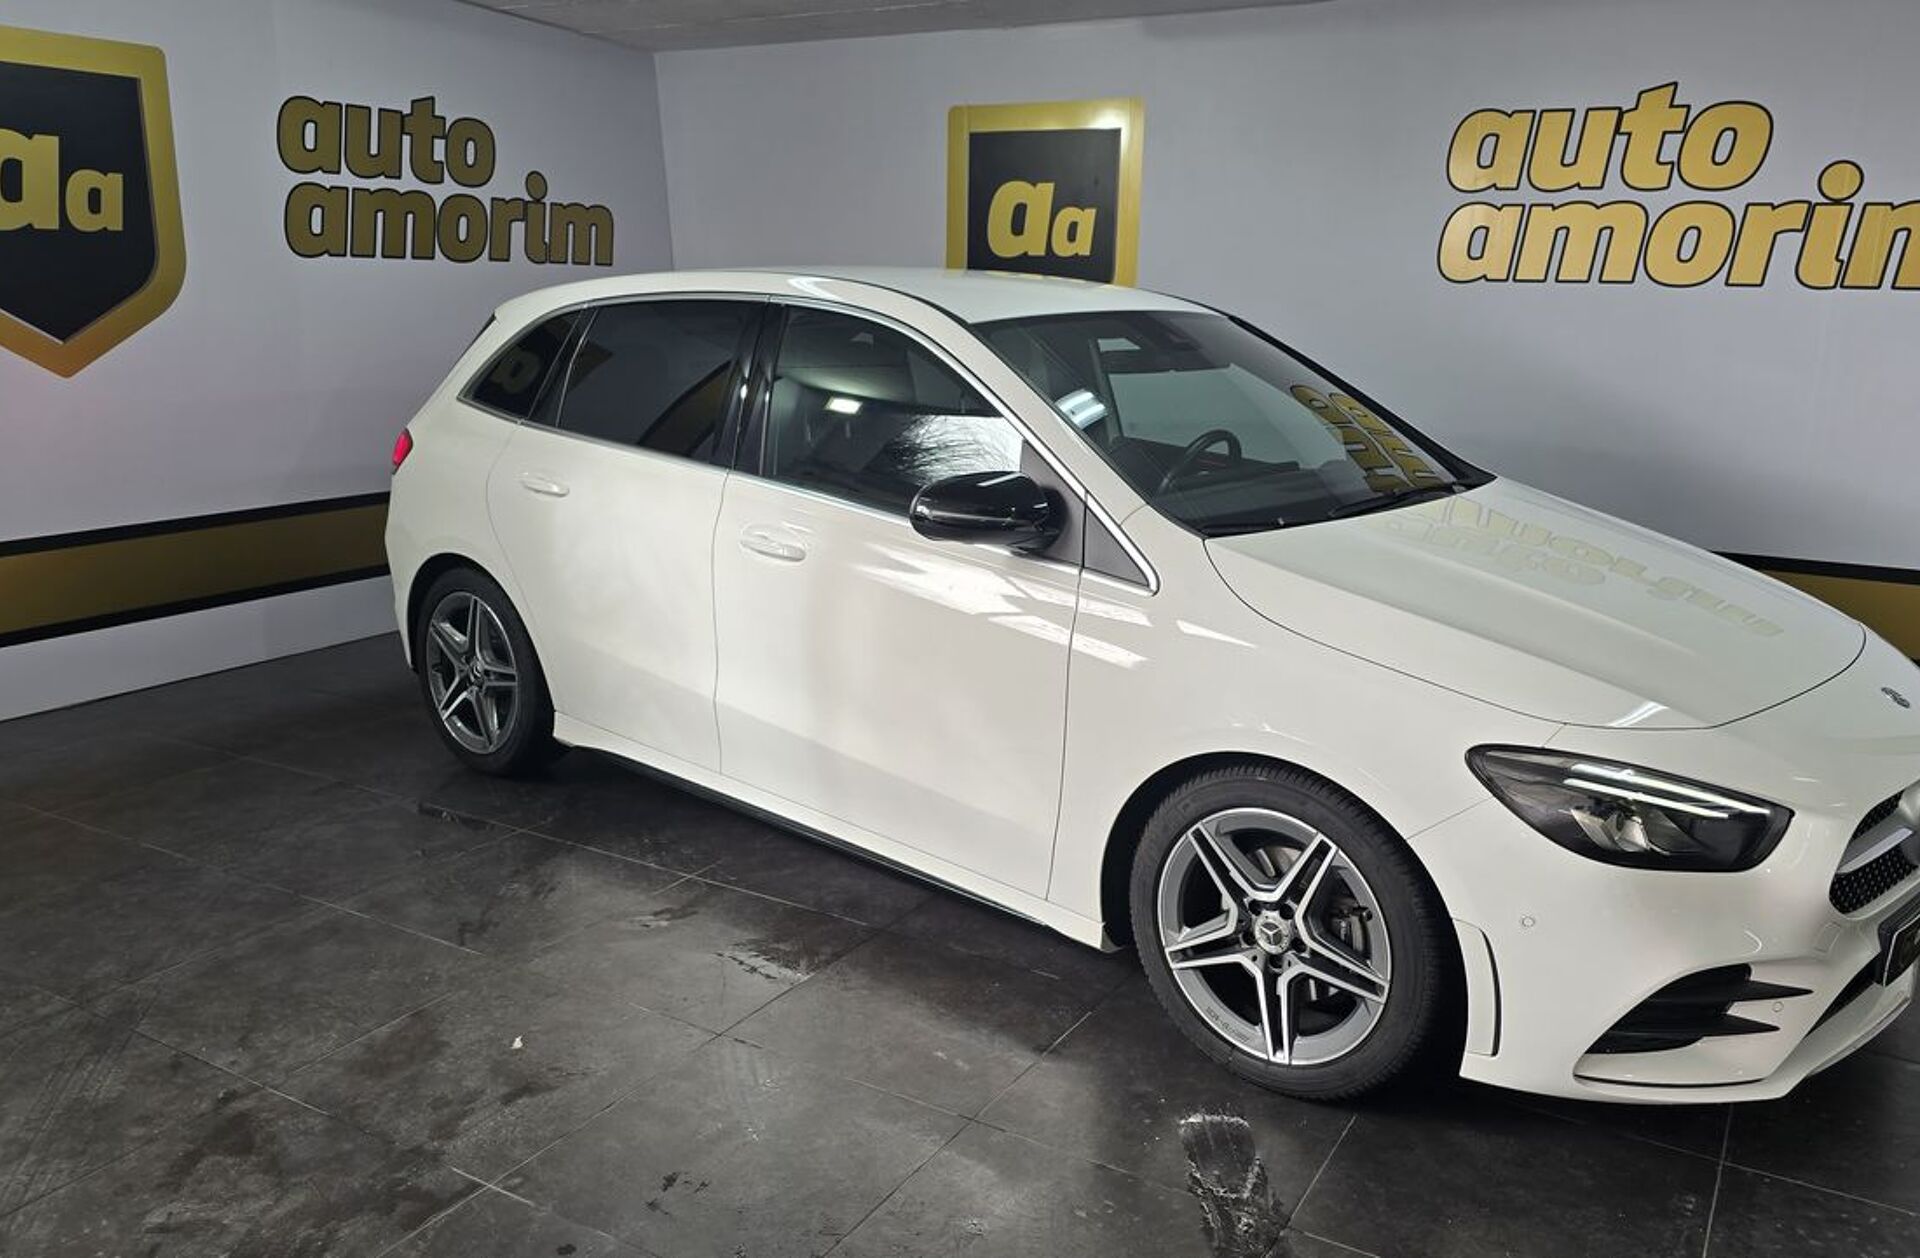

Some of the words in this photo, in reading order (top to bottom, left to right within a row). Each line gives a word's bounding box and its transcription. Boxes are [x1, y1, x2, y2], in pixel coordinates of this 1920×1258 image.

[277, 95, 496, 187] auto
[1446, 82, 1774, 193] auto
[284, 171, 614, 266] amorim
